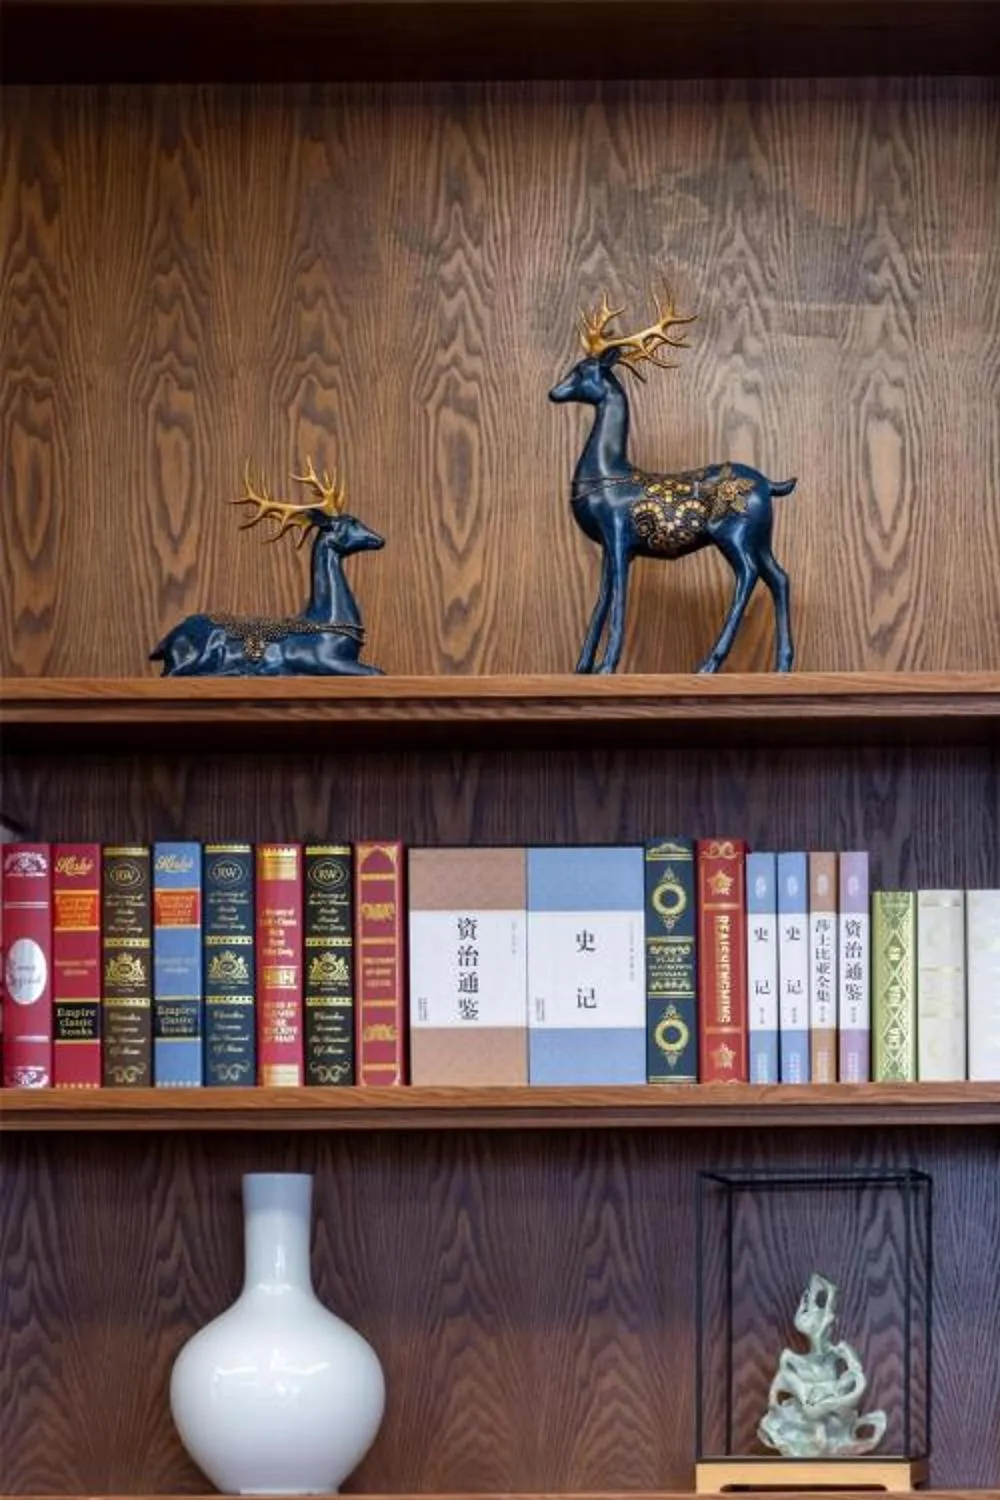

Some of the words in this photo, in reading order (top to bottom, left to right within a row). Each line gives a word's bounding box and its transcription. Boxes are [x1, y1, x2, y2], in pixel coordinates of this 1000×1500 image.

[457, 917, 479, 1021] 资治通鉴
[576, 929, 598, 1010] 史记
[753, 926, 771, 996] 史记
[785, 925, 803, 996] 史记
[814, 919, 832, 1003] 莎士比亚全集
[844, 918, 863, 1002] 资治通鉴
[57, 1007, 96, 1019] Empire
[59, 1017, 93, 1028] classic
[60, 1027, 93, 1037] books
